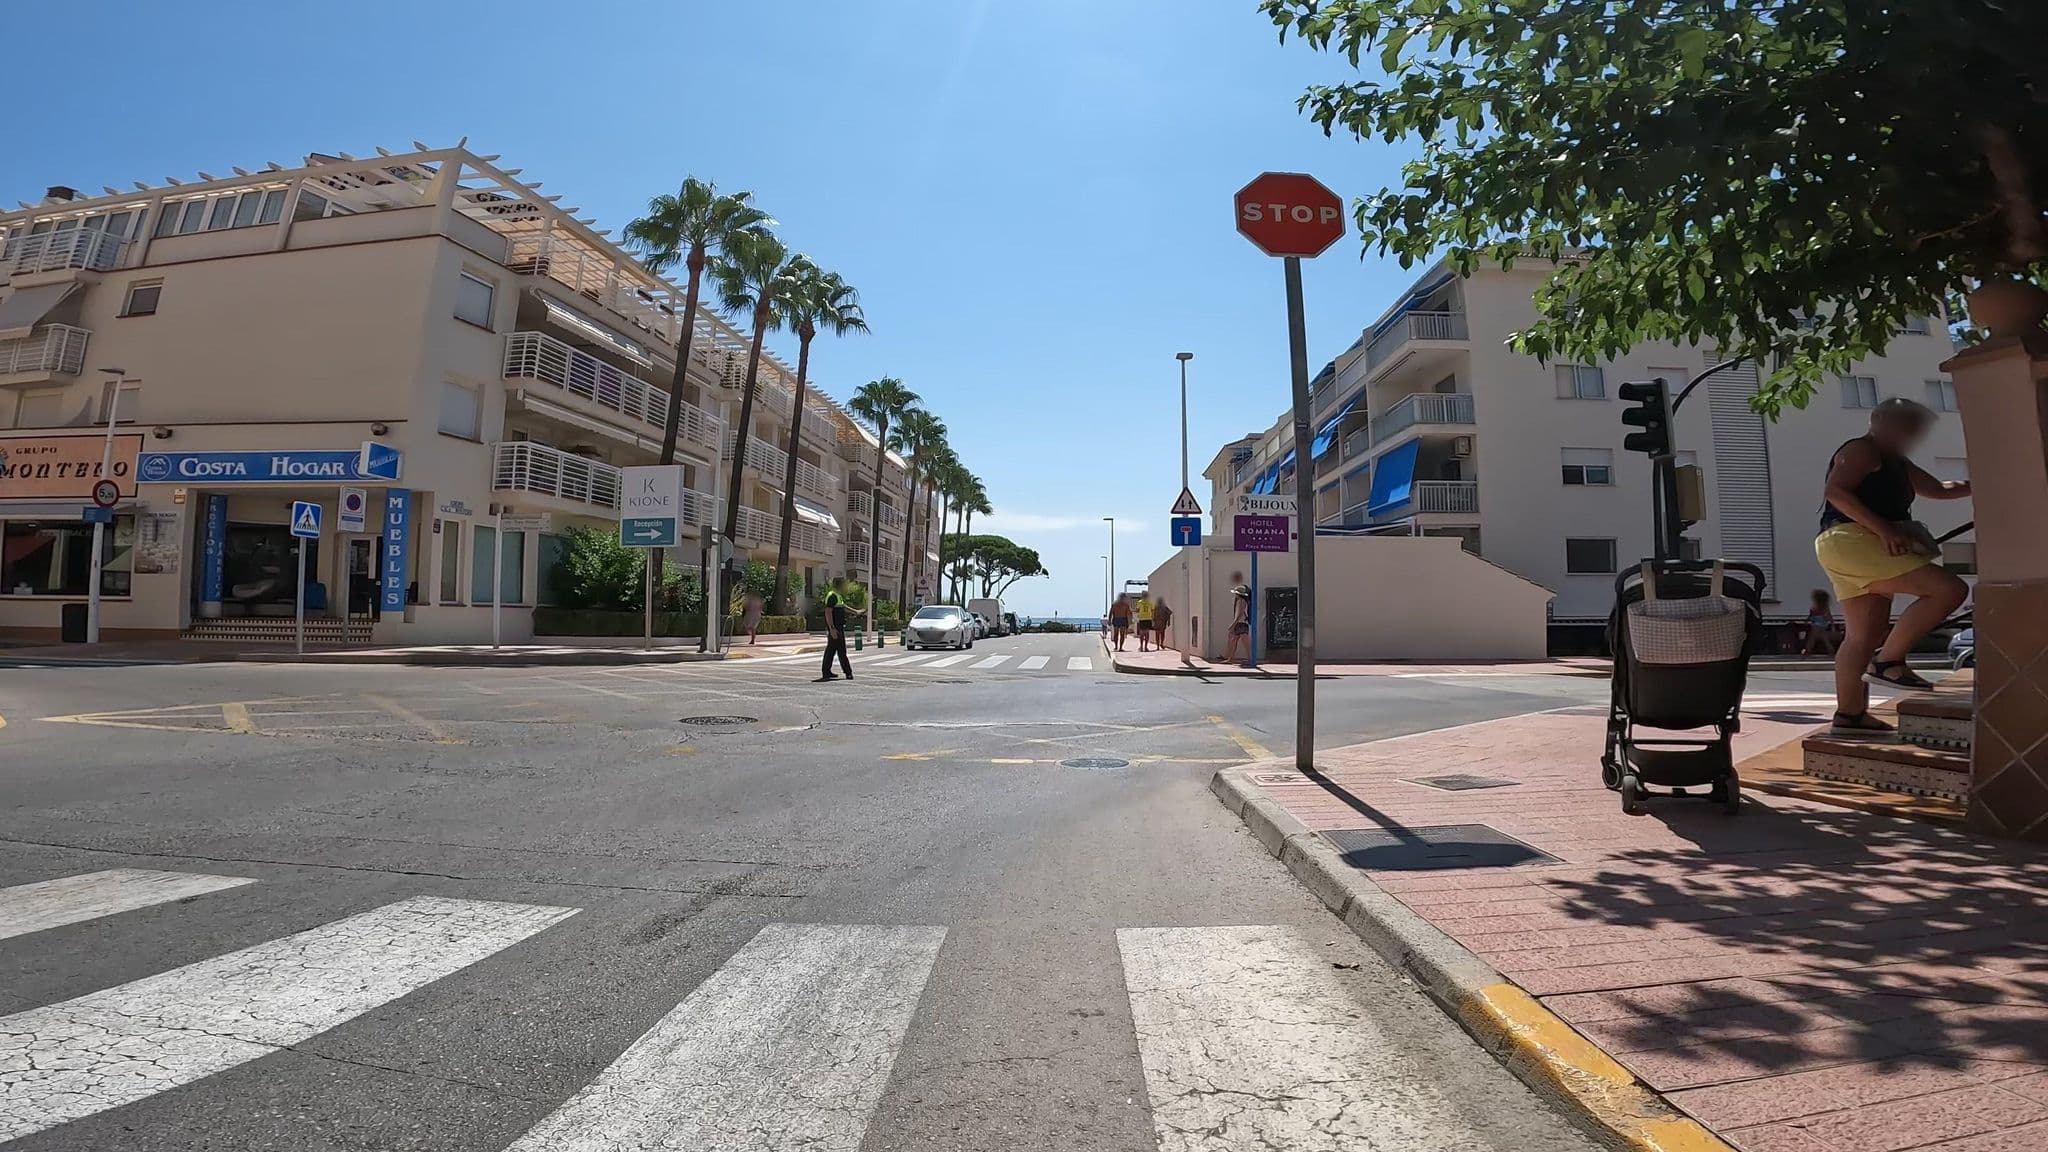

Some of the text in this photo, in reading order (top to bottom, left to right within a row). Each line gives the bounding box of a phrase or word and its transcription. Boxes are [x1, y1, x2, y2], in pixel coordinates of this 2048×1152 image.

[1242, 202, 1338, 225] STOP
[15, 447, 58, 455] GRUPO
[179, 456, 345, 477] COSTA HOGAR
[643, 478, 655, 493] K
[629, 496, 670, 507] KIONE
[1250, 520, 1275, 528] HOTEL
[387, 497, 403, 605] MUEBLES
